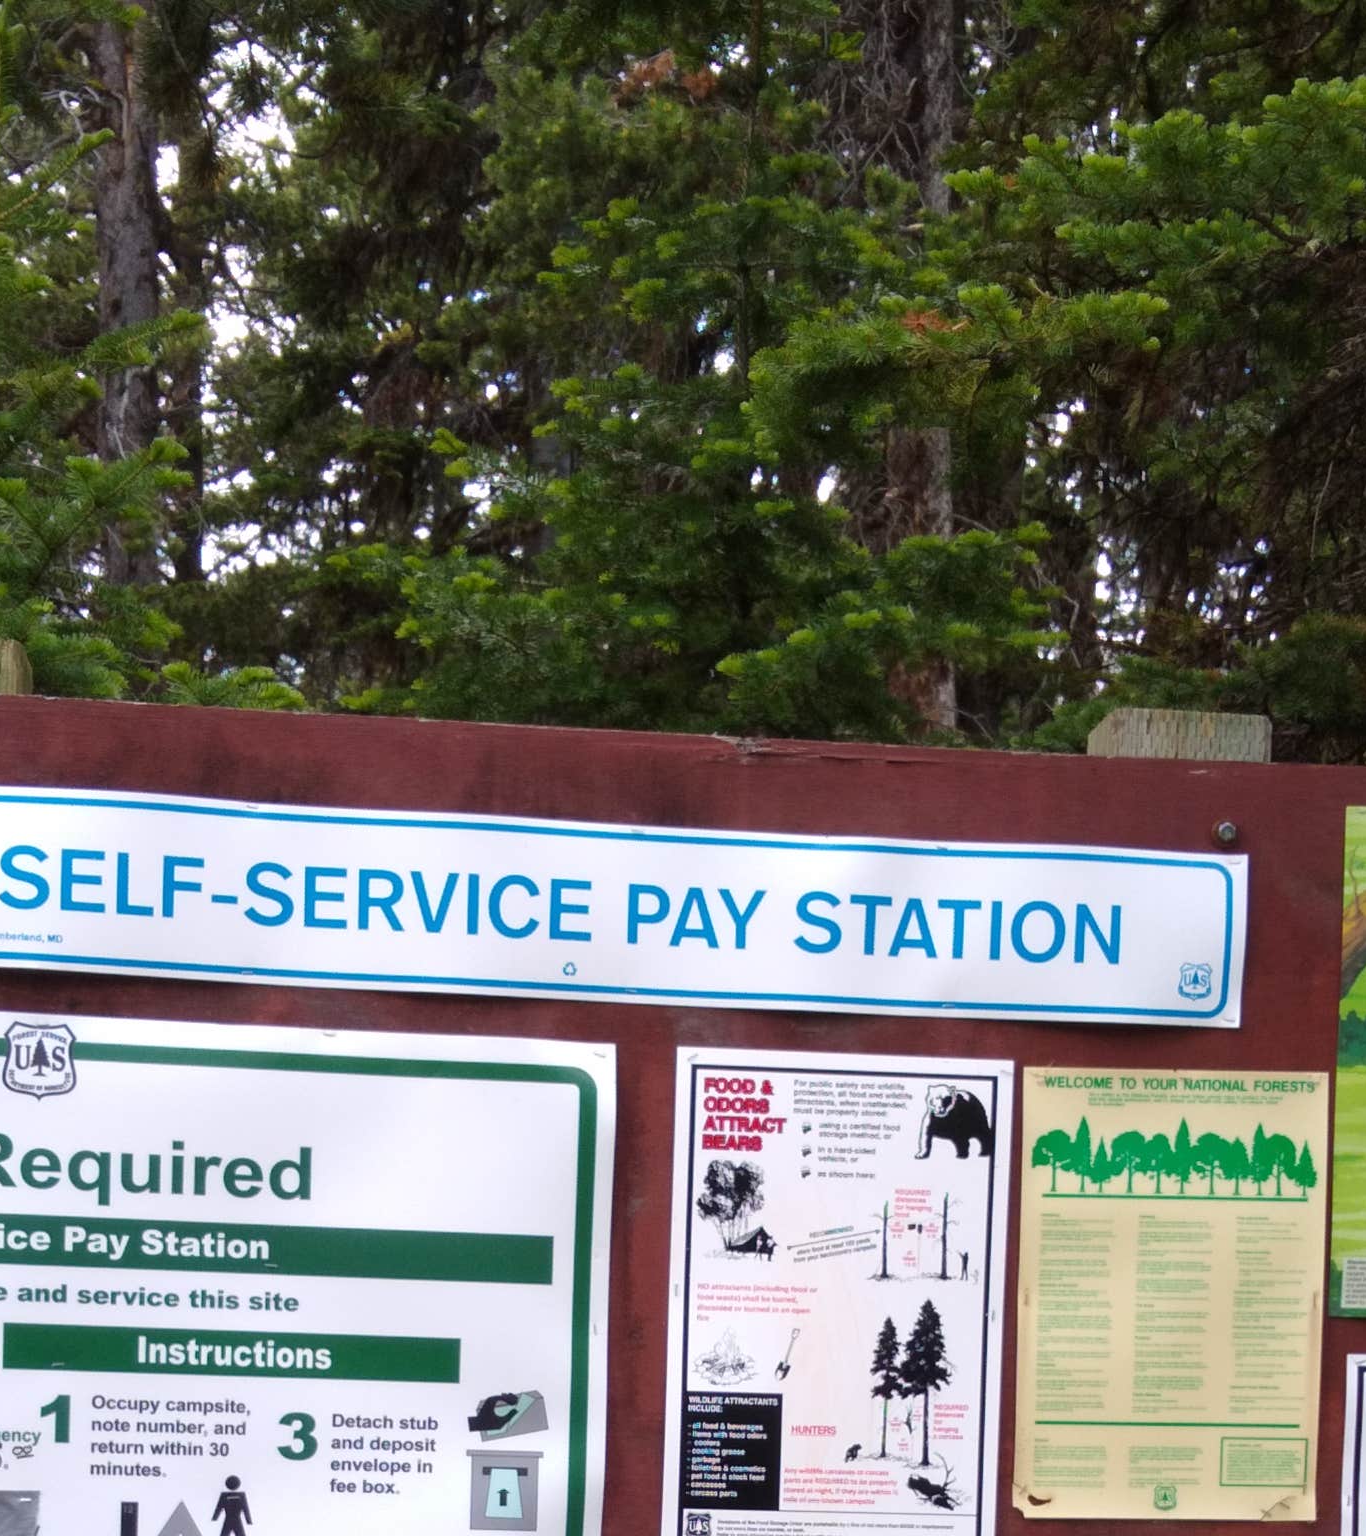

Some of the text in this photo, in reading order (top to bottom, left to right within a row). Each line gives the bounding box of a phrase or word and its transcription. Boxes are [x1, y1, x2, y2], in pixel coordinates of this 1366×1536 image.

[0, 847, 1121, 962] SELF-SERVICE PAY STATION
[704, 1077, 774, 1095] FOOD &
[1044, 1076, 1317, 1092] WELCOME TO YOUR NATIONAL FORESTS
[703, 1096, 771, 1115] ODORS
[702, 1115, 787, 1135] ATTRACT
[701, 1134, 764, 1152] BEARS
[64, 1226, 128, 1259] Pay
[141, 1230, 268, 1258] Station
[17, 1284, 66, 1302] and
[77, 1287, 179, 1306] service
[189, 1290, 239, 1309] this
[249, 1292, 298, 1311] site
[138, 1337, 331, 1368] Instructions
[91, 1395, 249, 1415] Occupy campsite,
[38, 1395, 70, 1443] 1
[91, 1419, 245, 1435] note number, and
[332, 1414, 438, 1430] Detach stub
[278, 1412, 317, 1460] 3
[791, 1425, 836, 1435] HUNTERS
[91, 1441, 229, 1456] return within 30
[331, 1436, 435, 1453] and deposit
[90, 1462, 168, 1476] minutes.
[330, 1459, 432, 1475] envelope in
[330, 1478, 398, 1493] fee box.
